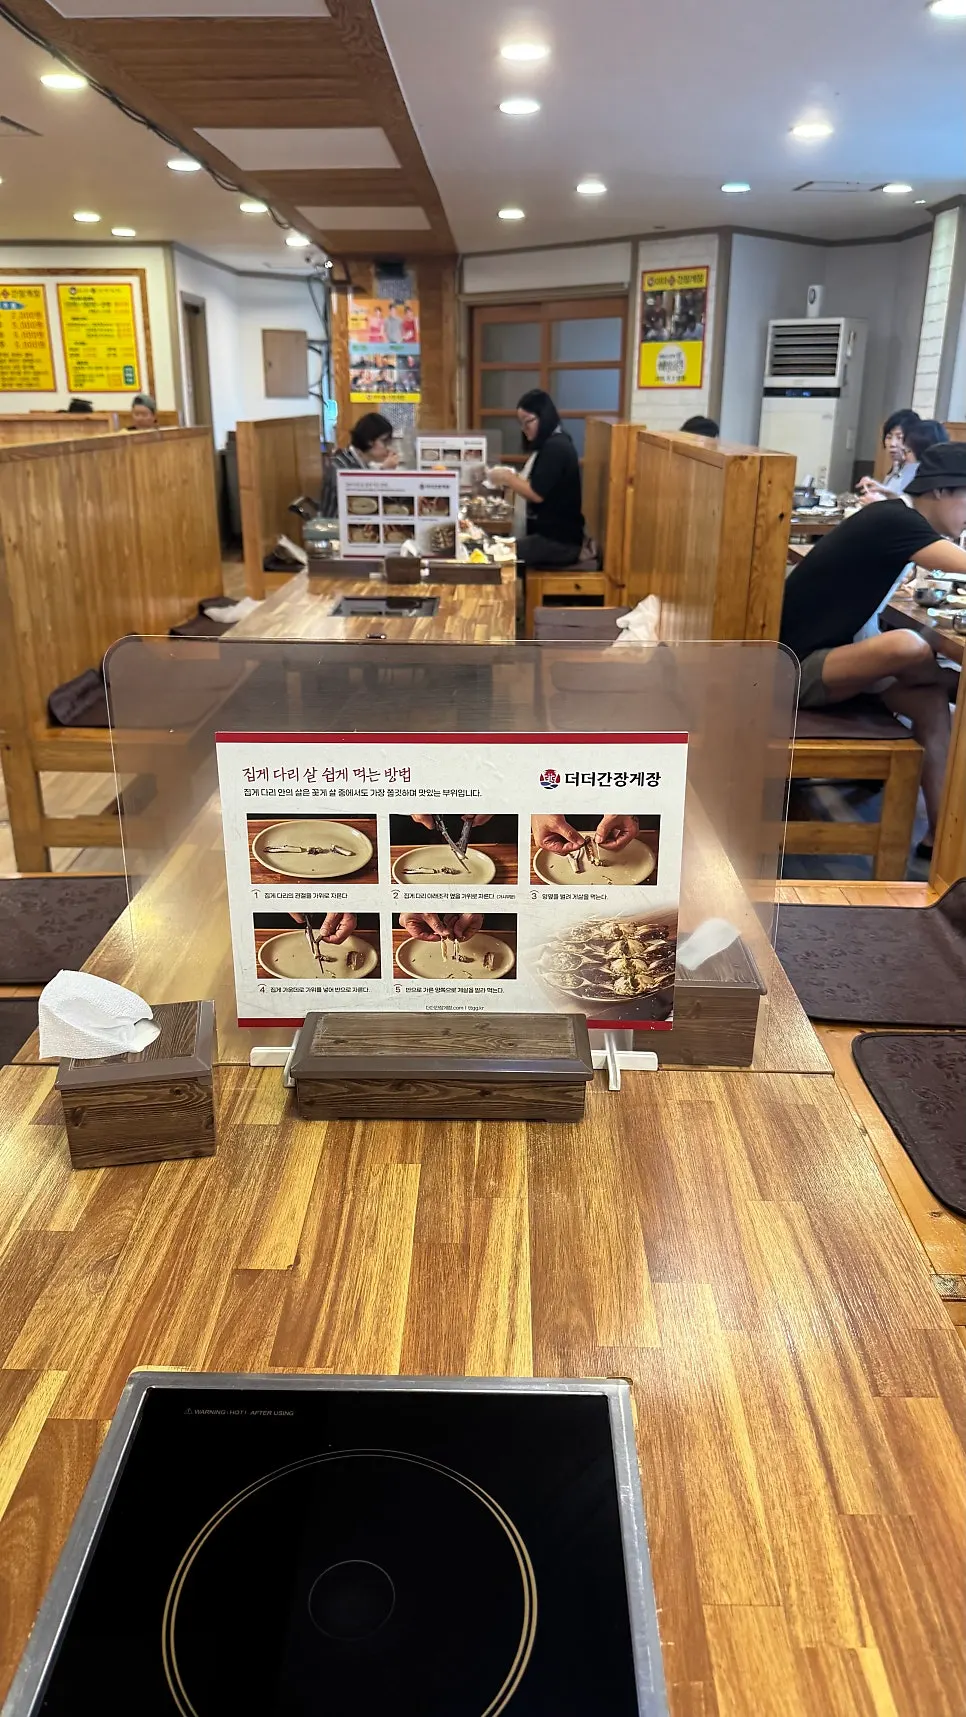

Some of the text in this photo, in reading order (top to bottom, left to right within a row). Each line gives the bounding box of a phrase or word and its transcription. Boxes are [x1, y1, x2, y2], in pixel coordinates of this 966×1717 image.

[242, 766, 411, 783] 집게 다리 살 쉽게 먹는 방법
[565, 772, 662, 787] 더더간장게장
[244, 788, 482, 797] 집게 다리 안의 살은 꽃게 살 중에서도 가장 쫄깃하며 맛있는 부위입니다.
